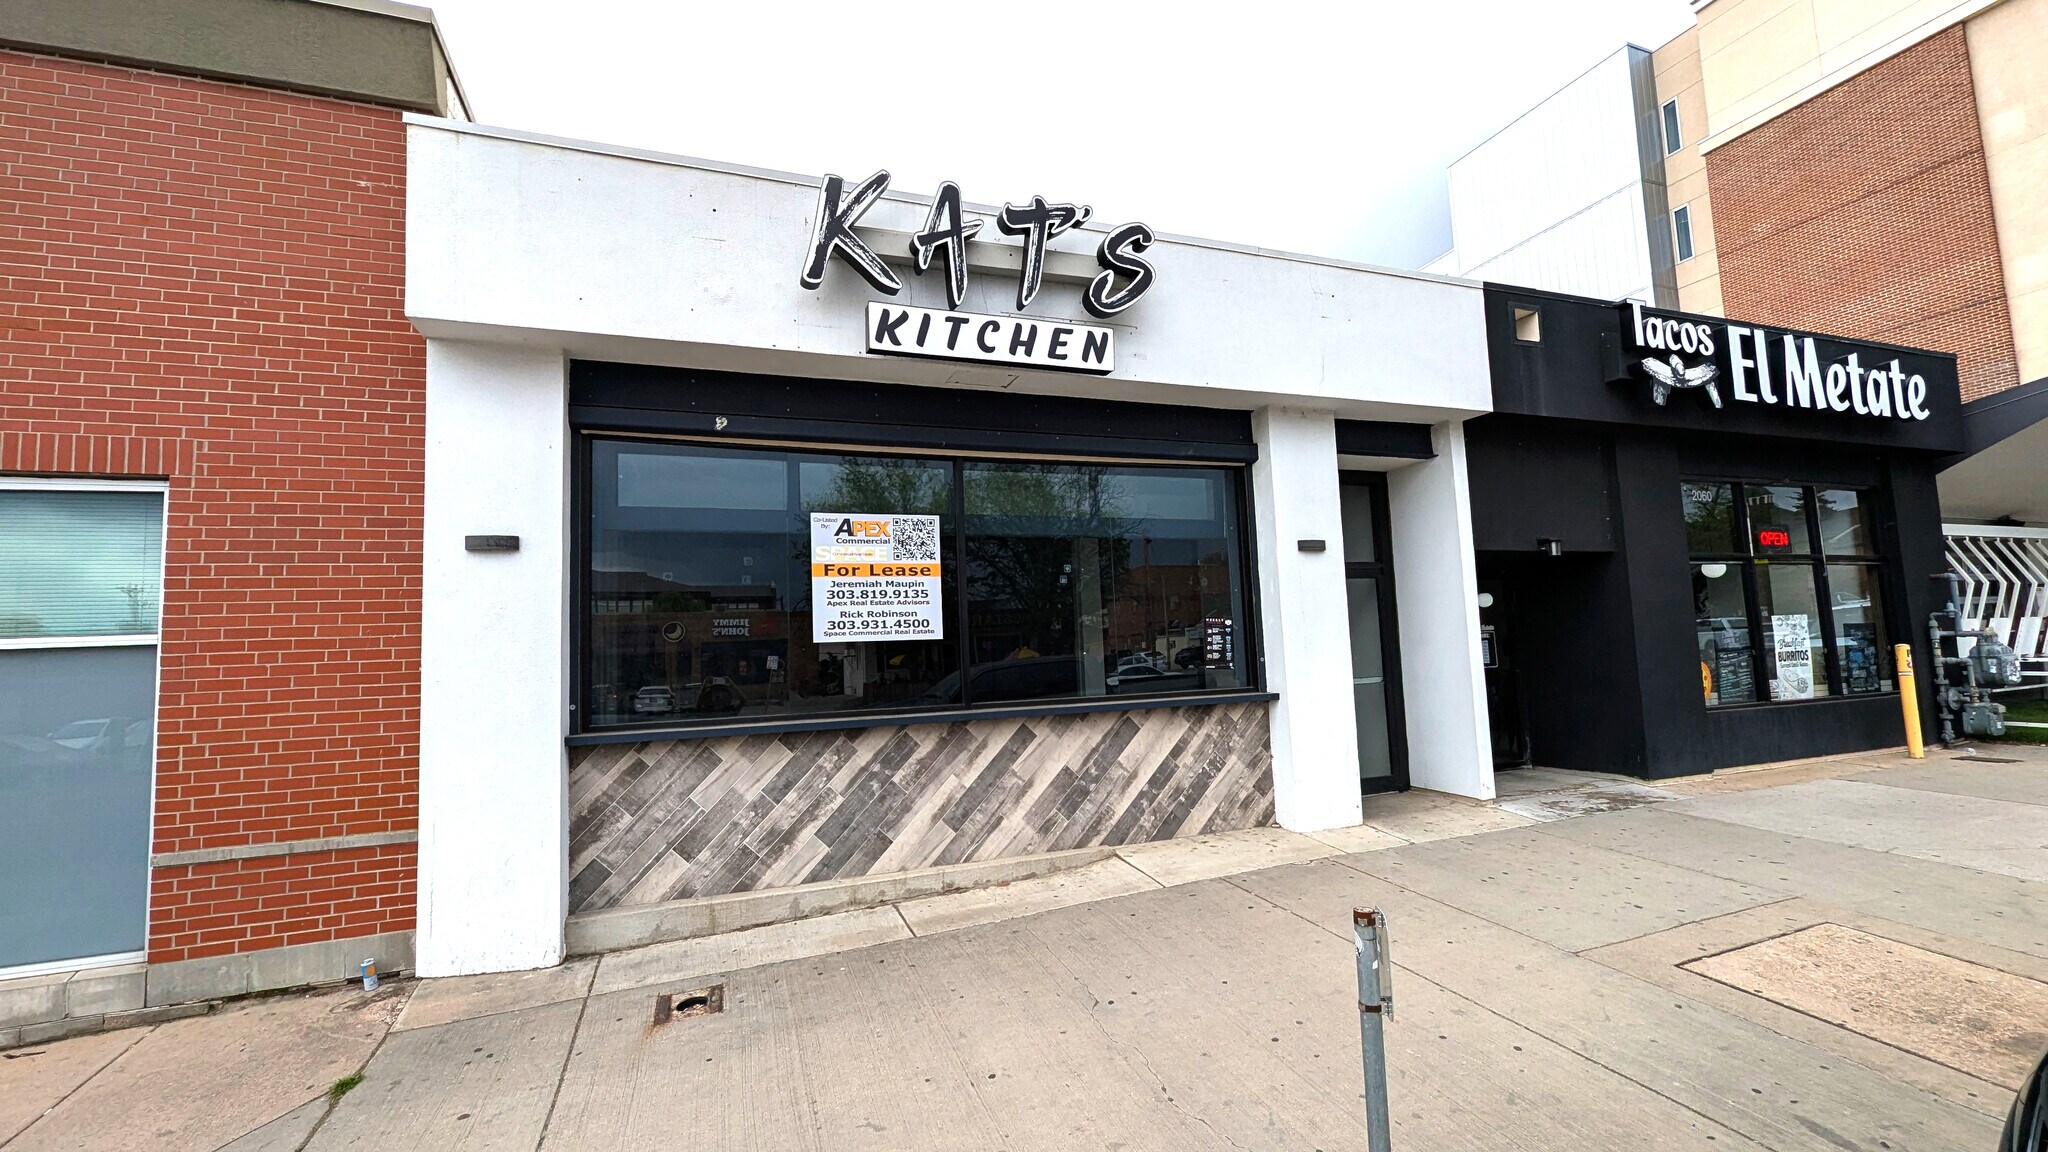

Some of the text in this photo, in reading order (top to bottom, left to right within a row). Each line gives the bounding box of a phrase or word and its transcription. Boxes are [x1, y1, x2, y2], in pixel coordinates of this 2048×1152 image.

[800, 169, 1156, 319] KAT'S
[1626, 299, 1716, 356] Tacos
[874, 308, 1110, 365] KITCHEN
[1727, 325, 1930, 421] El Metate
[1691, 490, 1713, 502] 2060
[834, 518, 891, 537] APEX
[836, 537, 891, 545] Commercial
[1760, 531, 1789, 546] OPEN
[823, 564, 932, 577] For Lease
[830, 580, 925, 589] Jeremiah Maupin
[826, 590, 929, 600] 303.819.9135
[840, 610, 918, 618] Rick Robinson
[827, 619, 930, 630] 303.931.4500
[1777, 649, 1809, 662] BURRITOS
